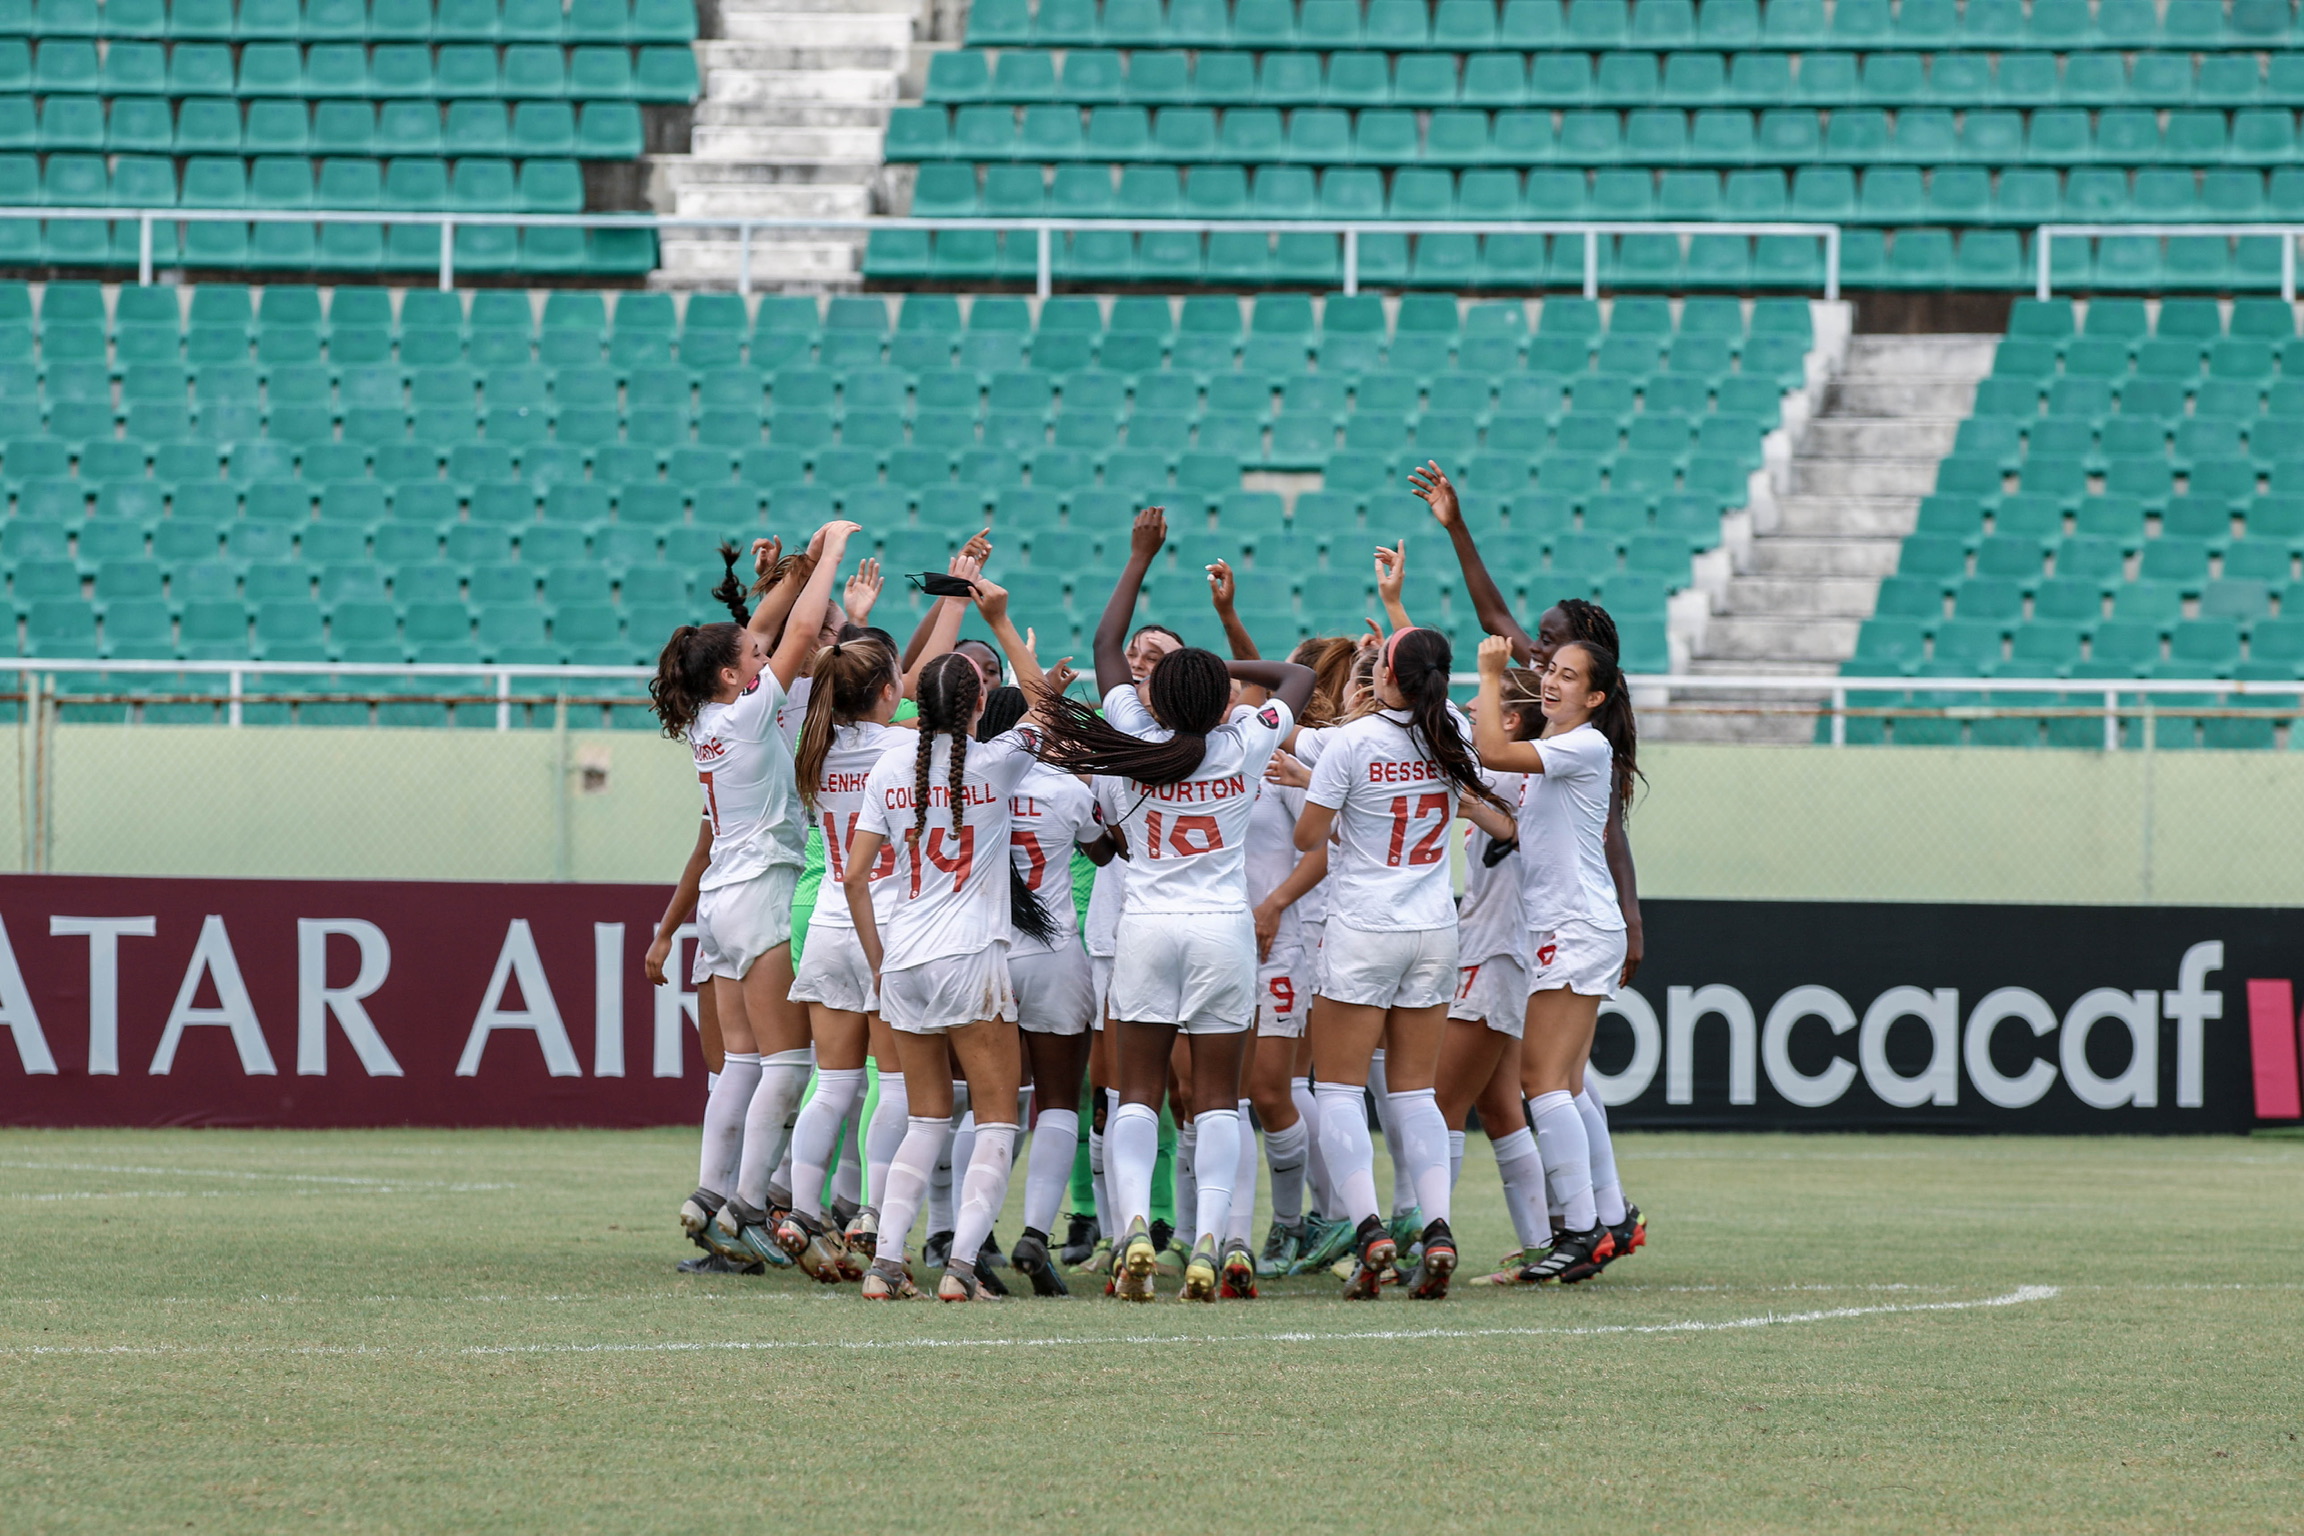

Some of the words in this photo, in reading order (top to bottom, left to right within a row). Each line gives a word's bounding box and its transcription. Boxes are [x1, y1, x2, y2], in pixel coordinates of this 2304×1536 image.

[1009, 796, 1042, 817] LL
[1387, 792, 1450, 867] 12
[905, 825, 974, 900] 14
[1269, 976, 1295, 1013] 9
[1584, 940, 2224, 1109] oncacaf
